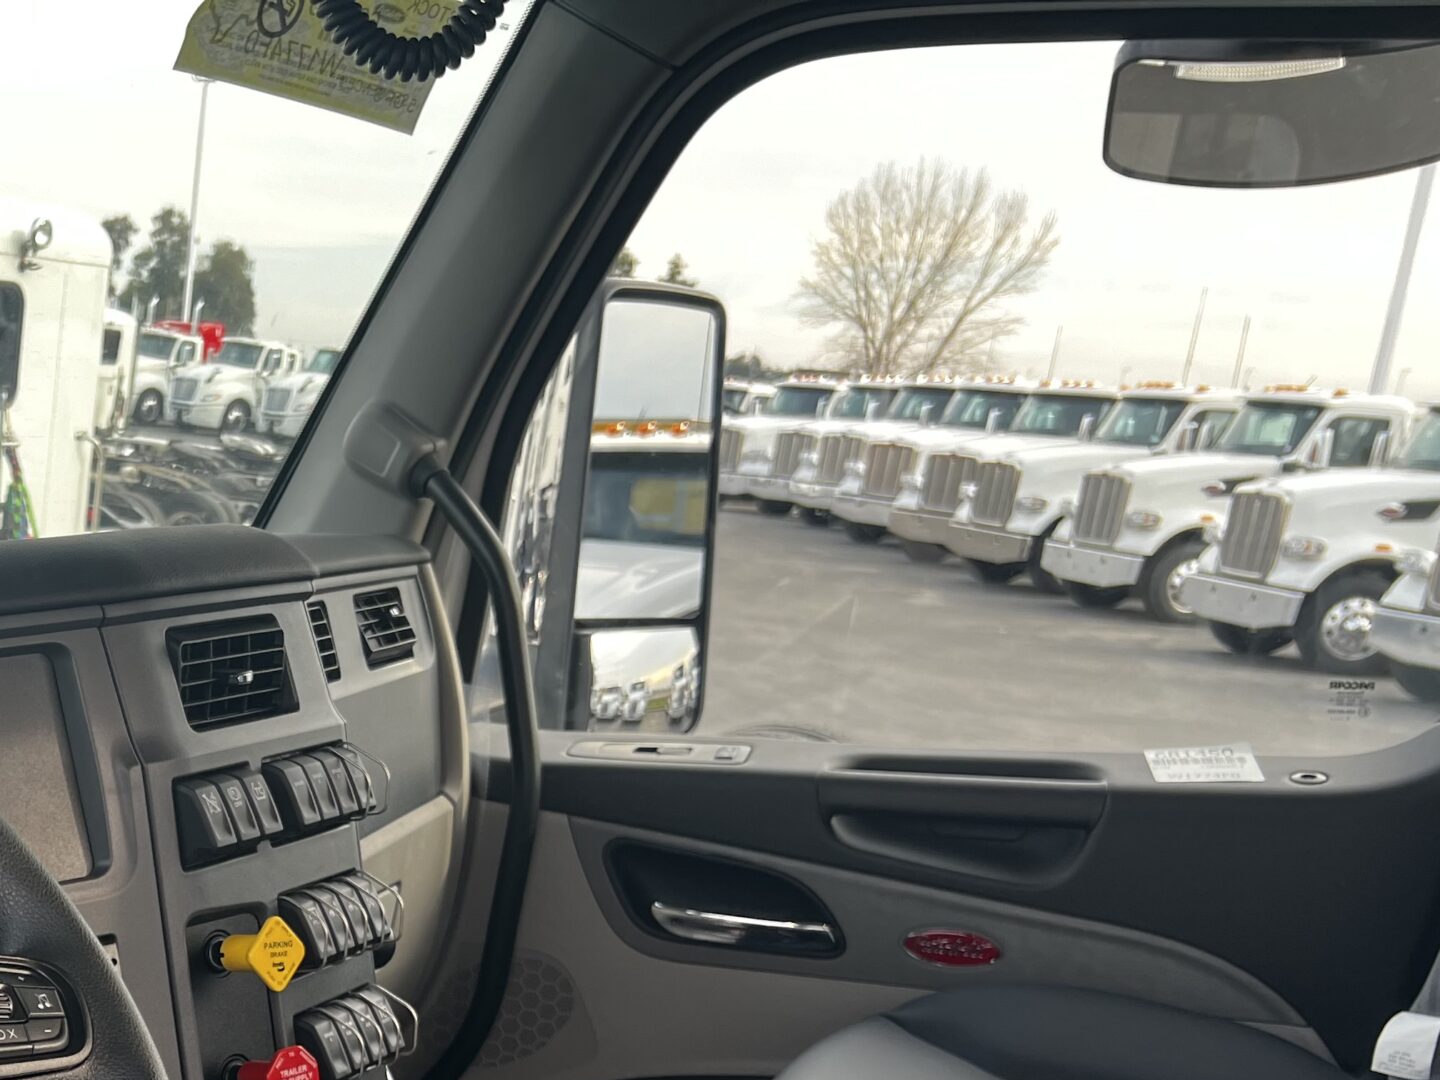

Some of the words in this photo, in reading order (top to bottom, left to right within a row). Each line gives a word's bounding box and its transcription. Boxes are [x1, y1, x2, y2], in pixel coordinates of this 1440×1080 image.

[263, 940, 293, 950] PARKING
[269, 950, 288, 958] BRAKE
[280, 1064, 307, 1079] TRAILER
